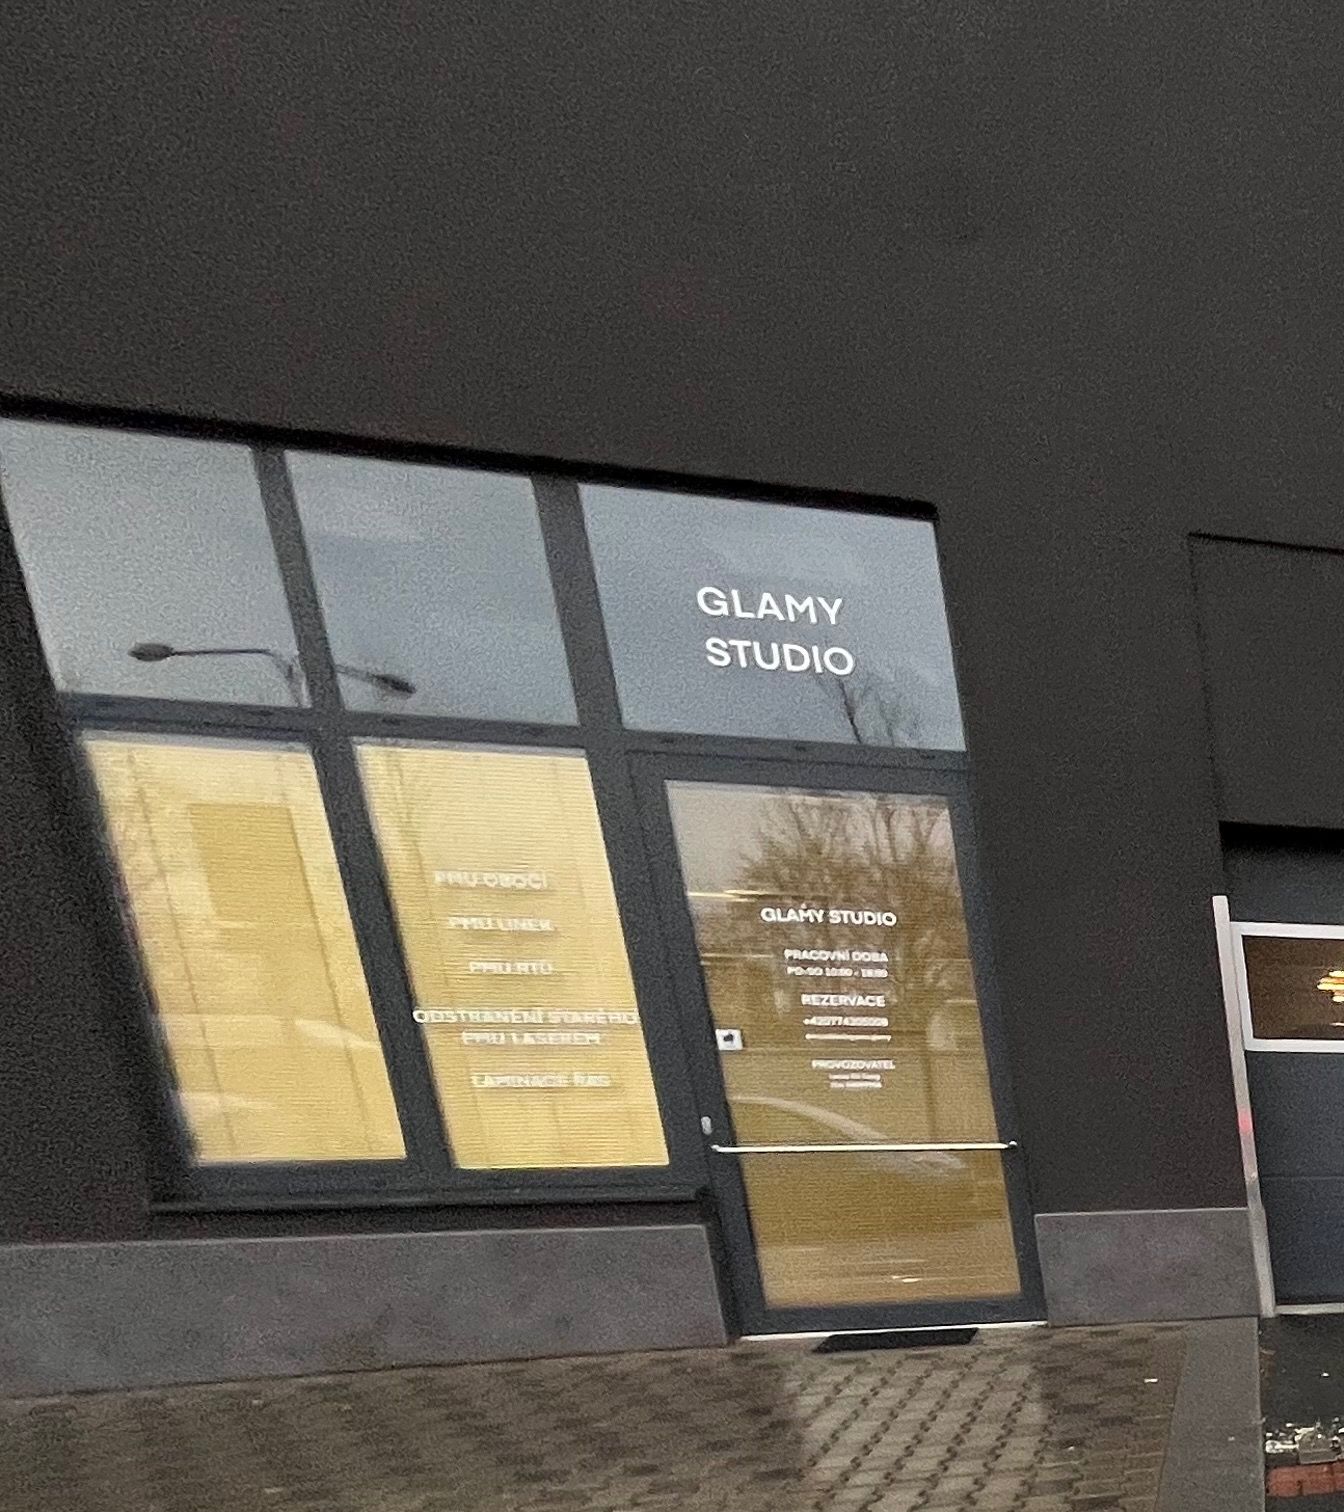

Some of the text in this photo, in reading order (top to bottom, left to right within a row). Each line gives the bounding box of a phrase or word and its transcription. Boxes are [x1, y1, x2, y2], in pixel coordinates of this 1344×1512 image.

[697, 586, 843, 625] GLAMY
[705, 637, 855, 676] STUDIO
[760, 907, 897, 926] GLAMY STUDIO
[801, 994, 886, 1007] REZERVACE
